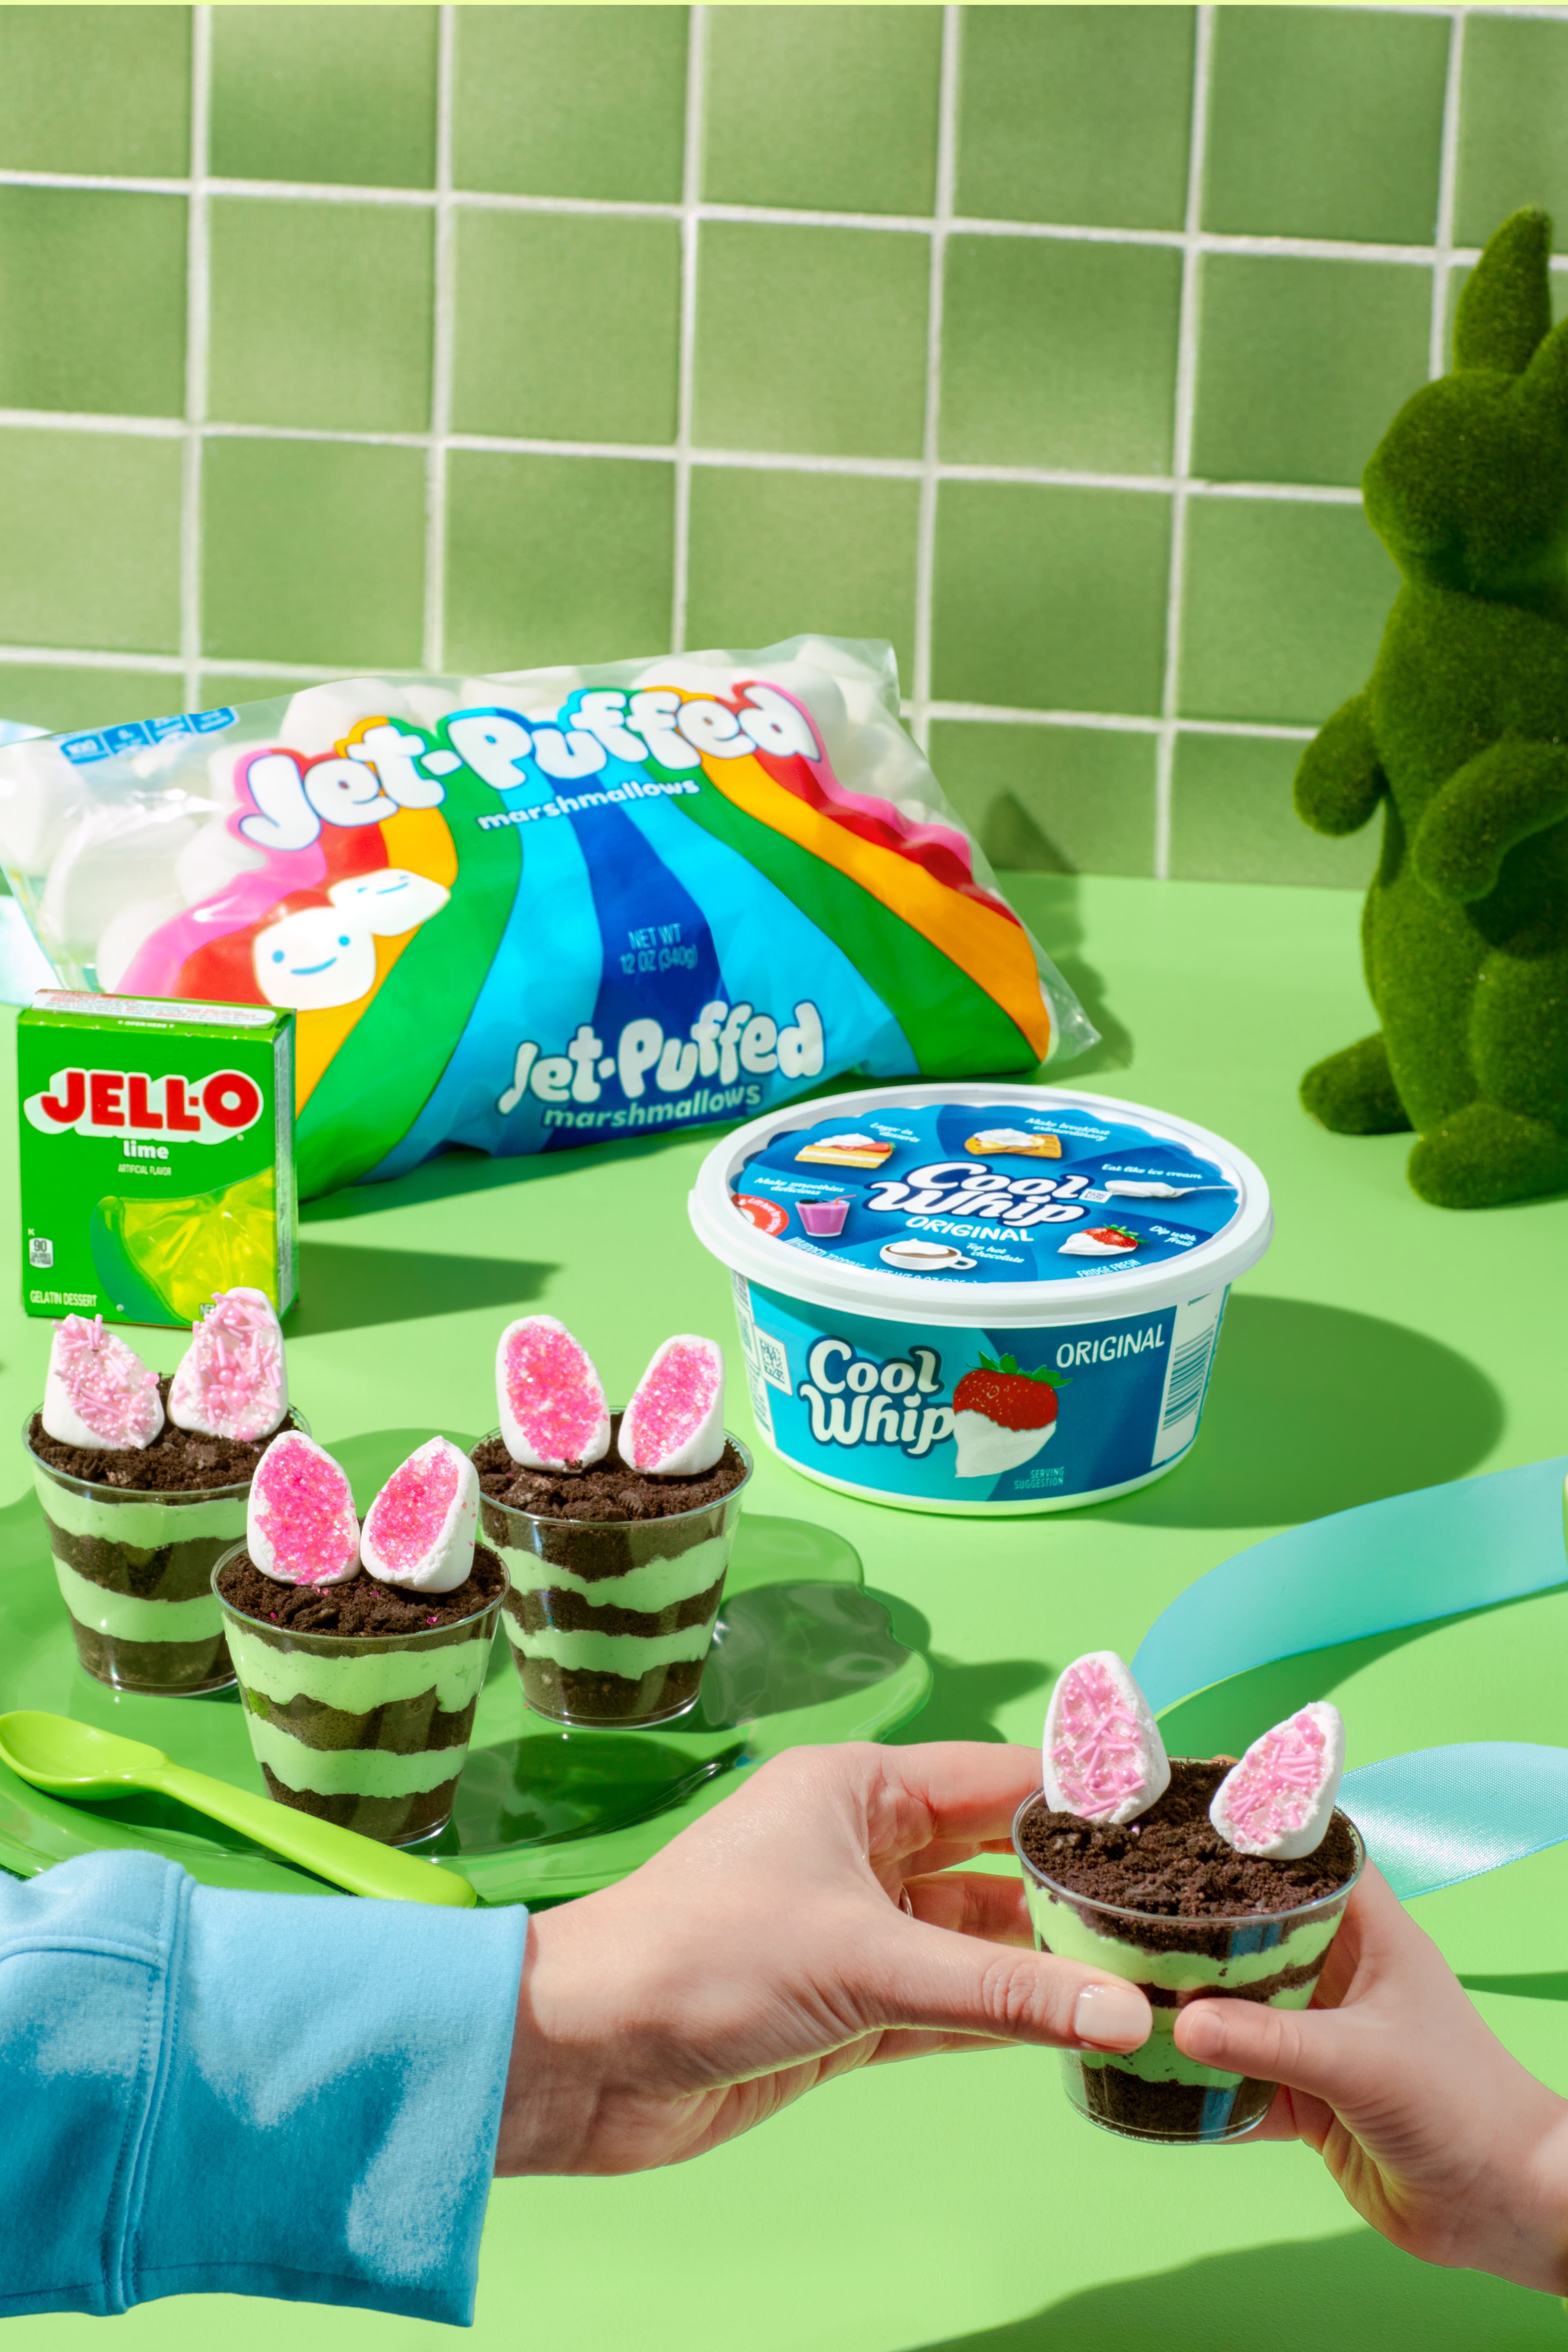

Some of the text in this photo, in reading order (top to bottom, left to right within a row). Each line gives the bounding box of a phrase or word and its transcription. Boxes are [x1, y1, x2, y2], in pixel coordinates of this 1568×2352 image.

[241, 685, 822, 851] Jet-Puffed
[478, 779, 700, 830] marshmallows
[628, 922, 681, 950] NET WT
[620, 943, 698, 974] 12 OZ (340g)
[498, 1001, 824, 1114] Jet-Puffed
[543, 1083, 762, 1128] marshmallows
[1025, 1118, 1110, 1135] Make breakfast
[1033, 1126, 1107, 1141] extraordinary
[123, 1140, 169, 1160] lime
[118, 1164, 172, 1176] ARTIFICIAL FLAVOR
[754, 1177, 845, 1193] Make smoothies
[907, 1162, 1089, 1199] Cool
[770, 1185, 822, 1195] delicious
[868, 1182, 1085, 1227] Whip
[905, 1216, 1034, 1242] ORIGINAL
[1149, 1225, 1197, 1242] Dip with
[34, 1240, 47, 1252] 90
[966, 1242, 1007, 1254] Top hot
[1164, 1237, 1194, 1247] fruit
[971, 1251, 1025, 1263] chocolate
[1076, 1259, 1141, 1277] FRIDGE FRESH
[30, 1290, 97, 1307] GELATIN DESSERT
[1056, 1323, 1165, 1369] ORIGINAL
[809, 1339, 939, 1394] Cool
[800, 1384, 955, 1455] Whip
[1030, 1466, 1065, 1479] SERVING
[1014, 1477, 1064, 1490] SUGGESTION
